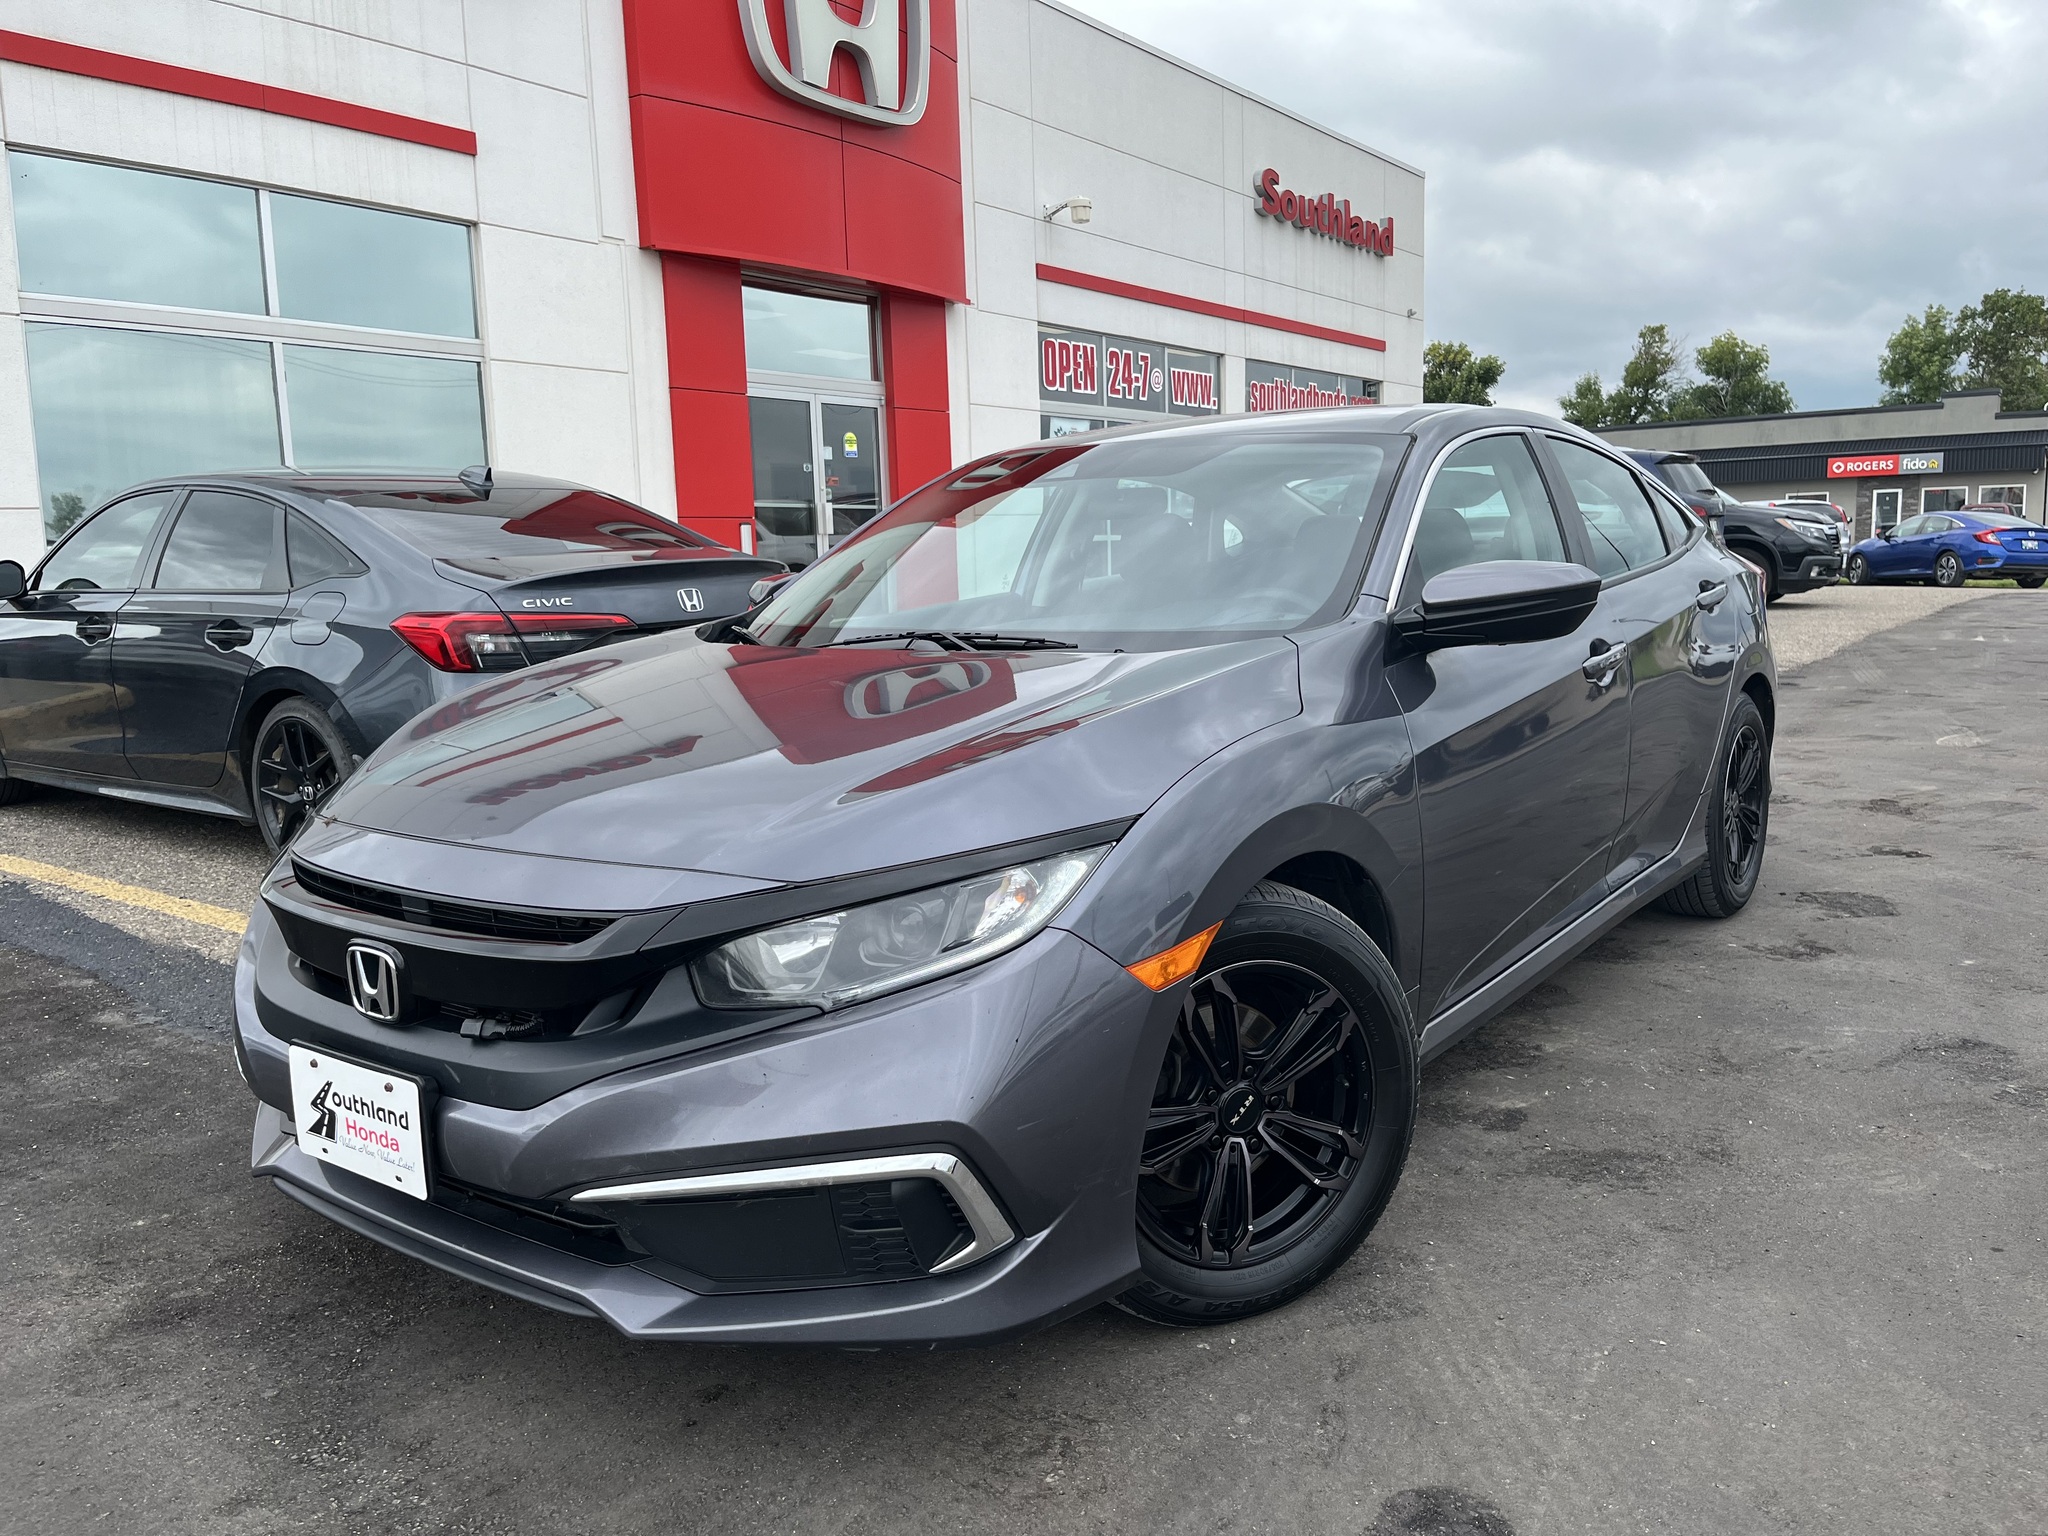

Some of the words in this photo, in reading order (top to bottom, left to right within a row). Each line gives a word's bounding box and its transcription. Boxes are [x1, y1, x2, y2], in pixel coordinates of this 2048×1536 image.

[1255, 168, 1394, 257] Southland
[1042, 338, 1097, 394] OPEN
[1846, 459, 1894, 472] ROGERS
[1902, 457, 1928, 471] fido
[522, 597, 574, 609] CIVIC
[1233, 917, 1327, 940] TOYO
[1229, 1094, 1254, 1126] RTX
[339, 1135, 357, 1151] Value
[376, 1149, 396, 1165] Value
[345, 1116, 400, 1153] Honda
